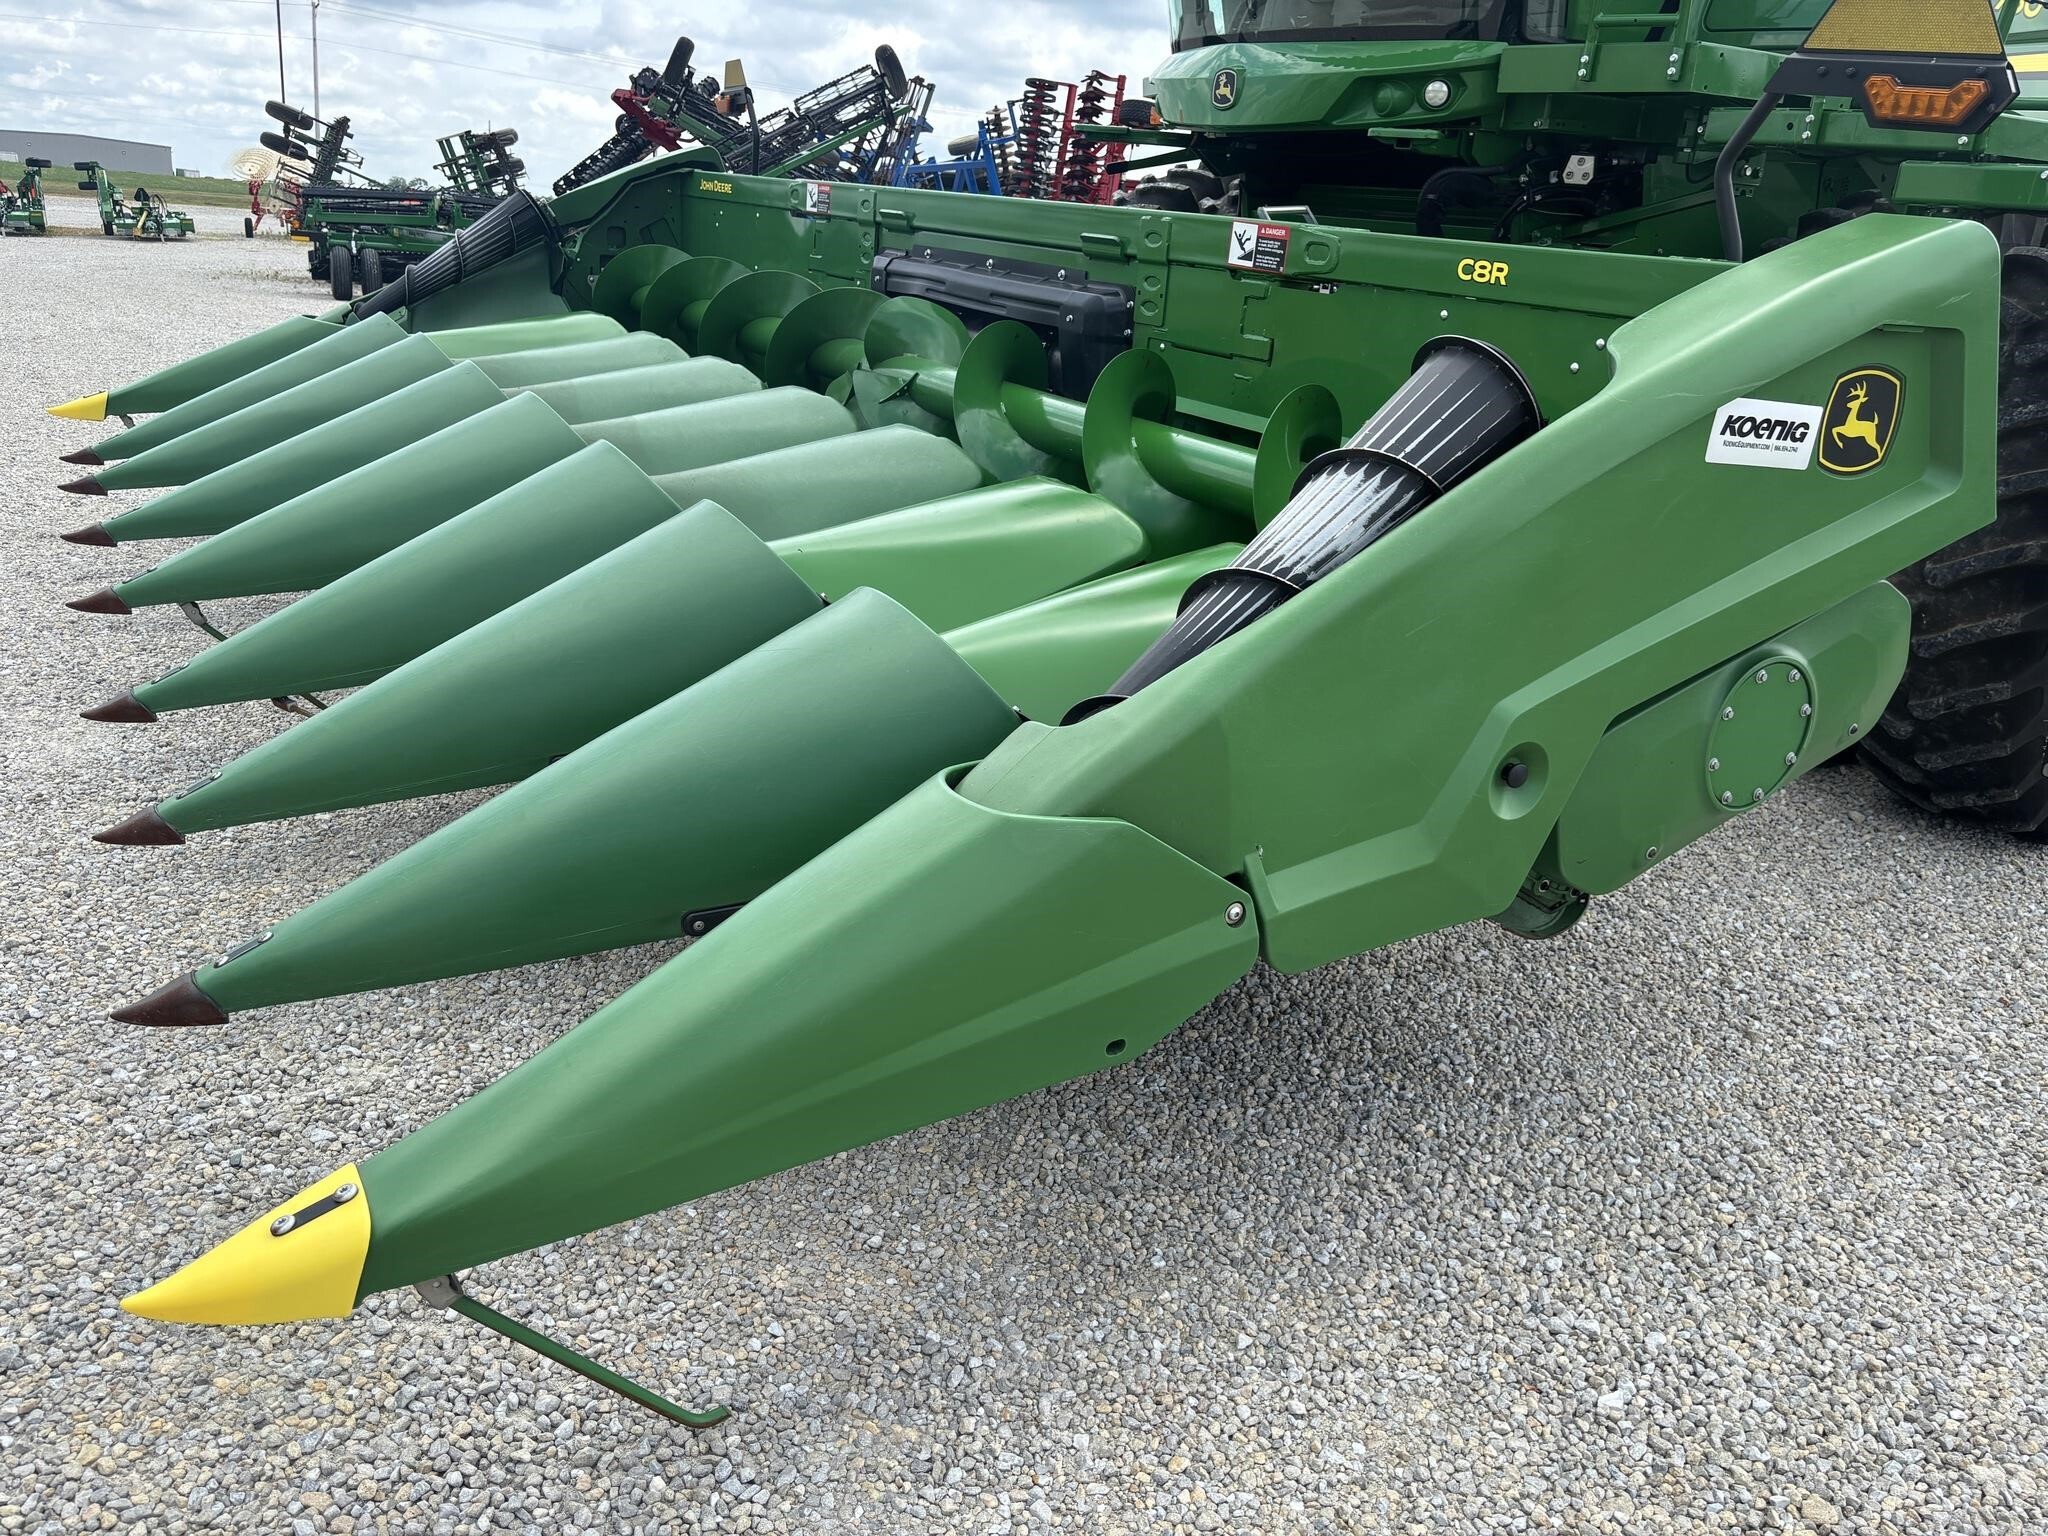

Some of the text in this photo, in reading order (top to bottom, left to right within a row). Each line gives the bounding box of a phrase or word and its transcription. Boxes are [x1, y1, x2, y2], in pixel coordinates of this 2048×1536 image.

[700, 179, 732, 193] JOHN DEERE
[1265, 227, 1286, 237] DANGER
[1457, 257, 1509, 286] C8R
